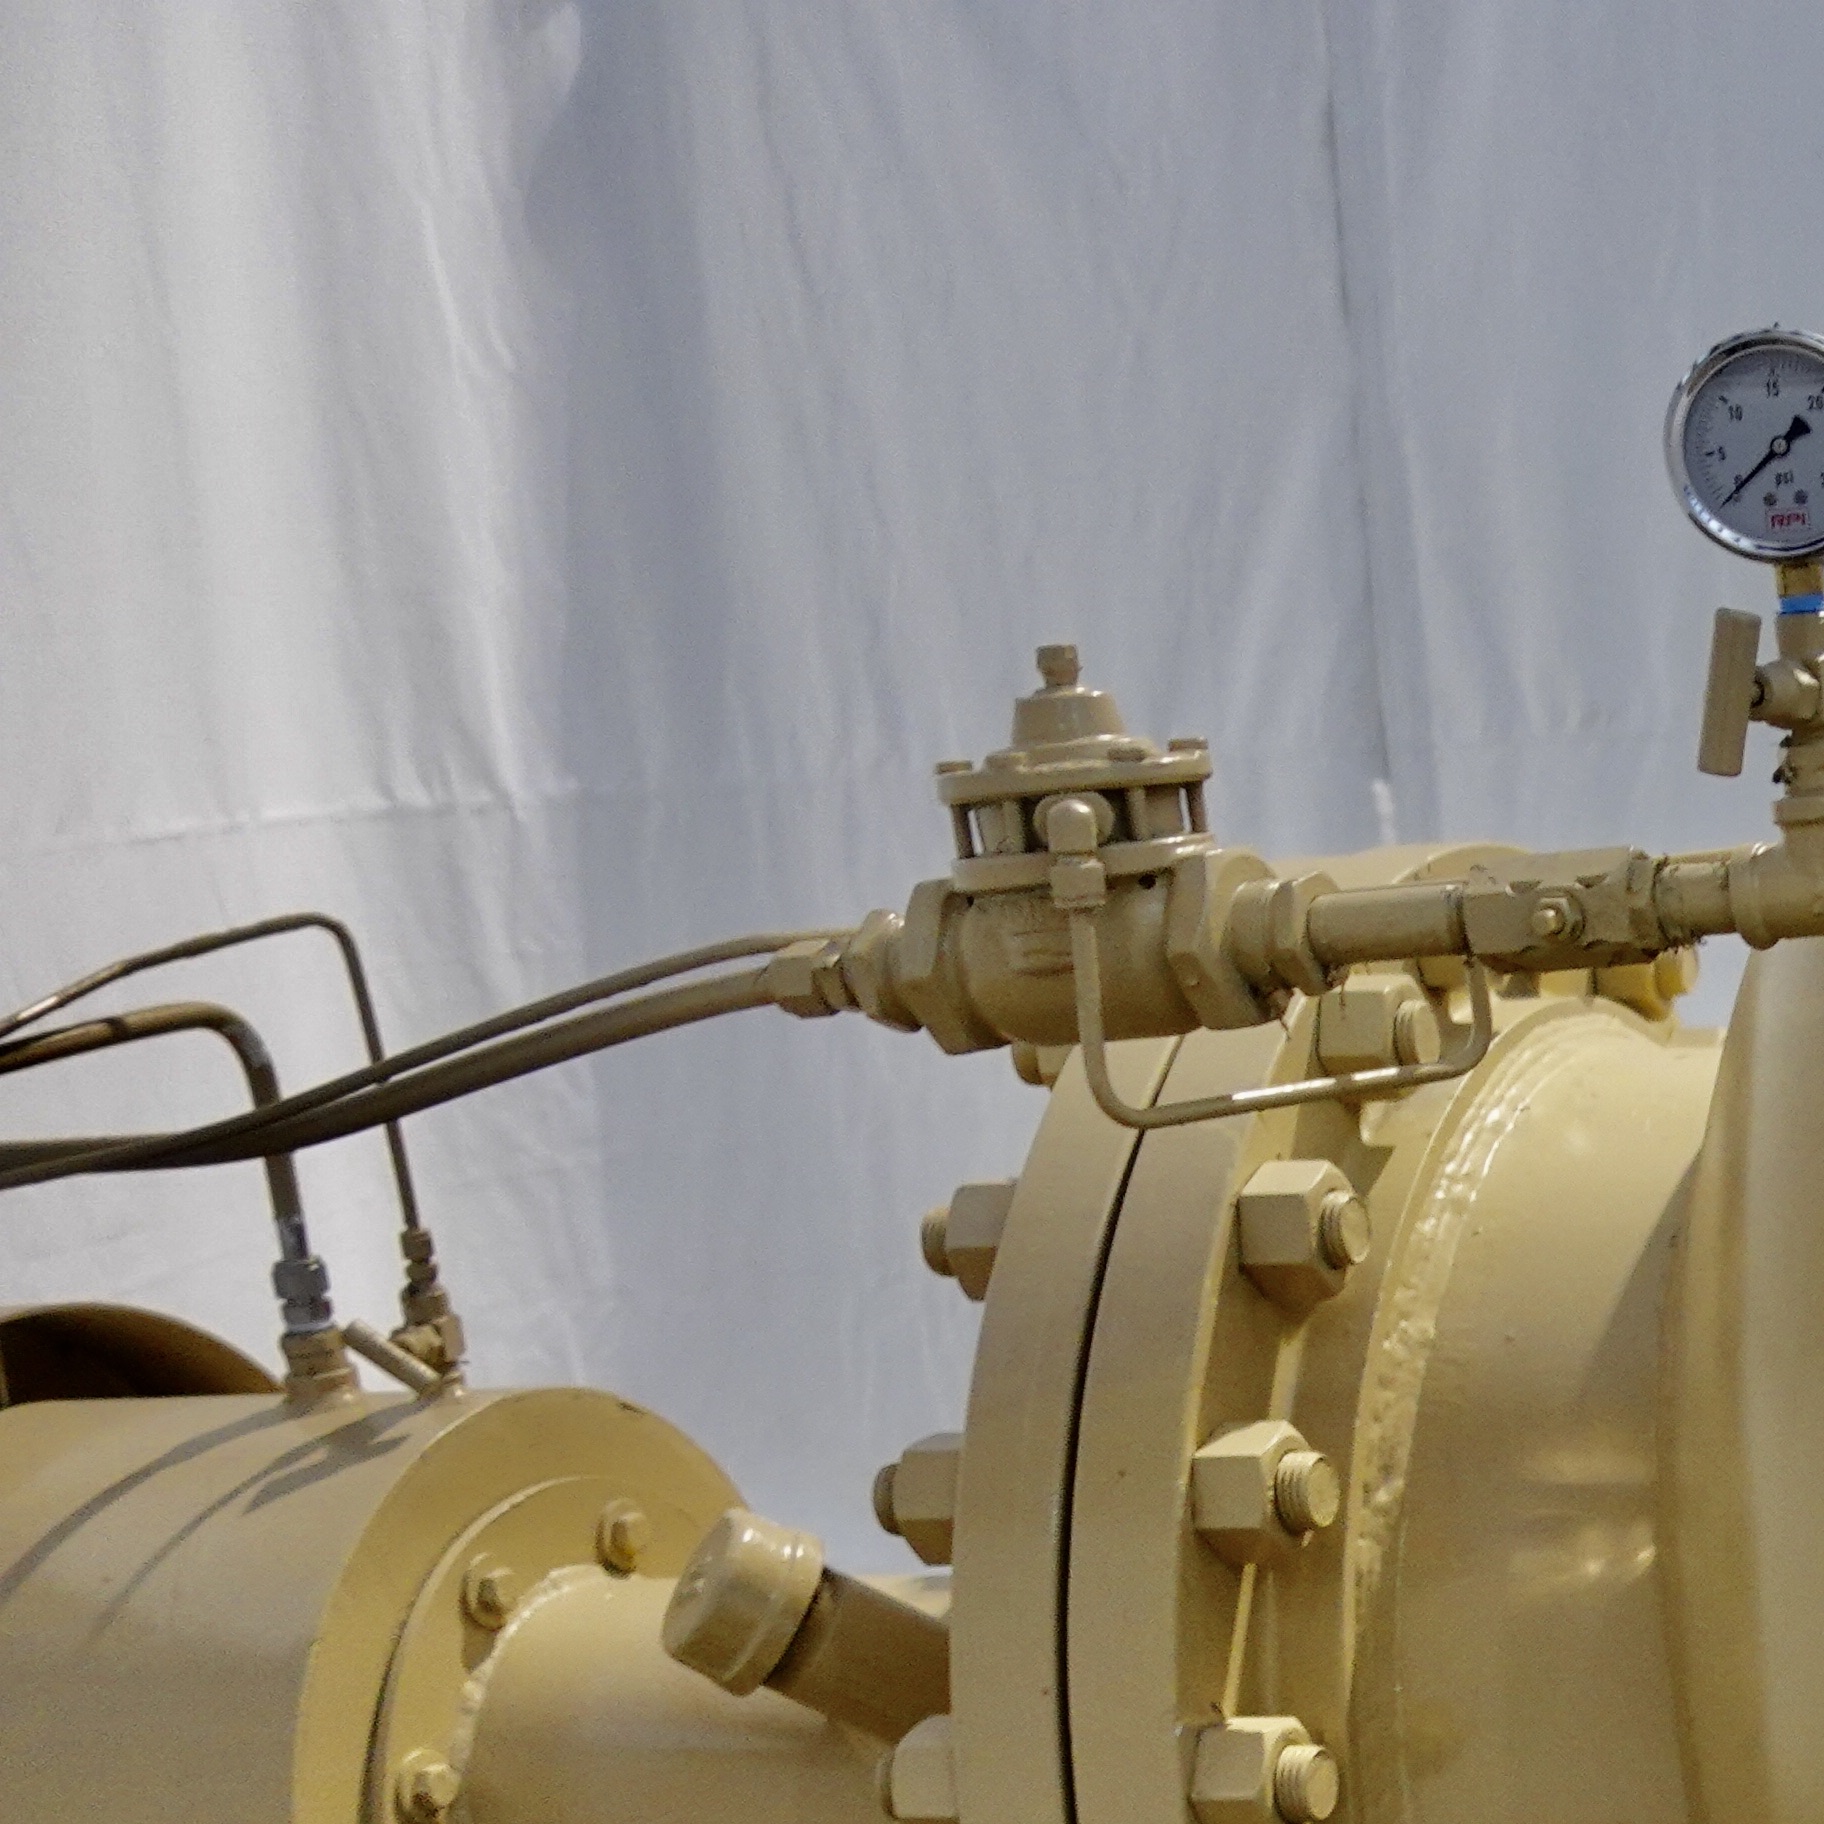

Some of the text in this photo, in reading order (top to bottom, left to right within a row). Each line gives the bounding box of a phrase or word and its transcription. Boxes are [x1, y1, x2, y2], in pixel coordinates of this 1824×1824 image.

[1766, 381, 1779, 396] 15
[1808, 395, 1824, 410] 20
[1729, 405, 1743, 421] 10
[1719, 446, 1726, 461] 5
